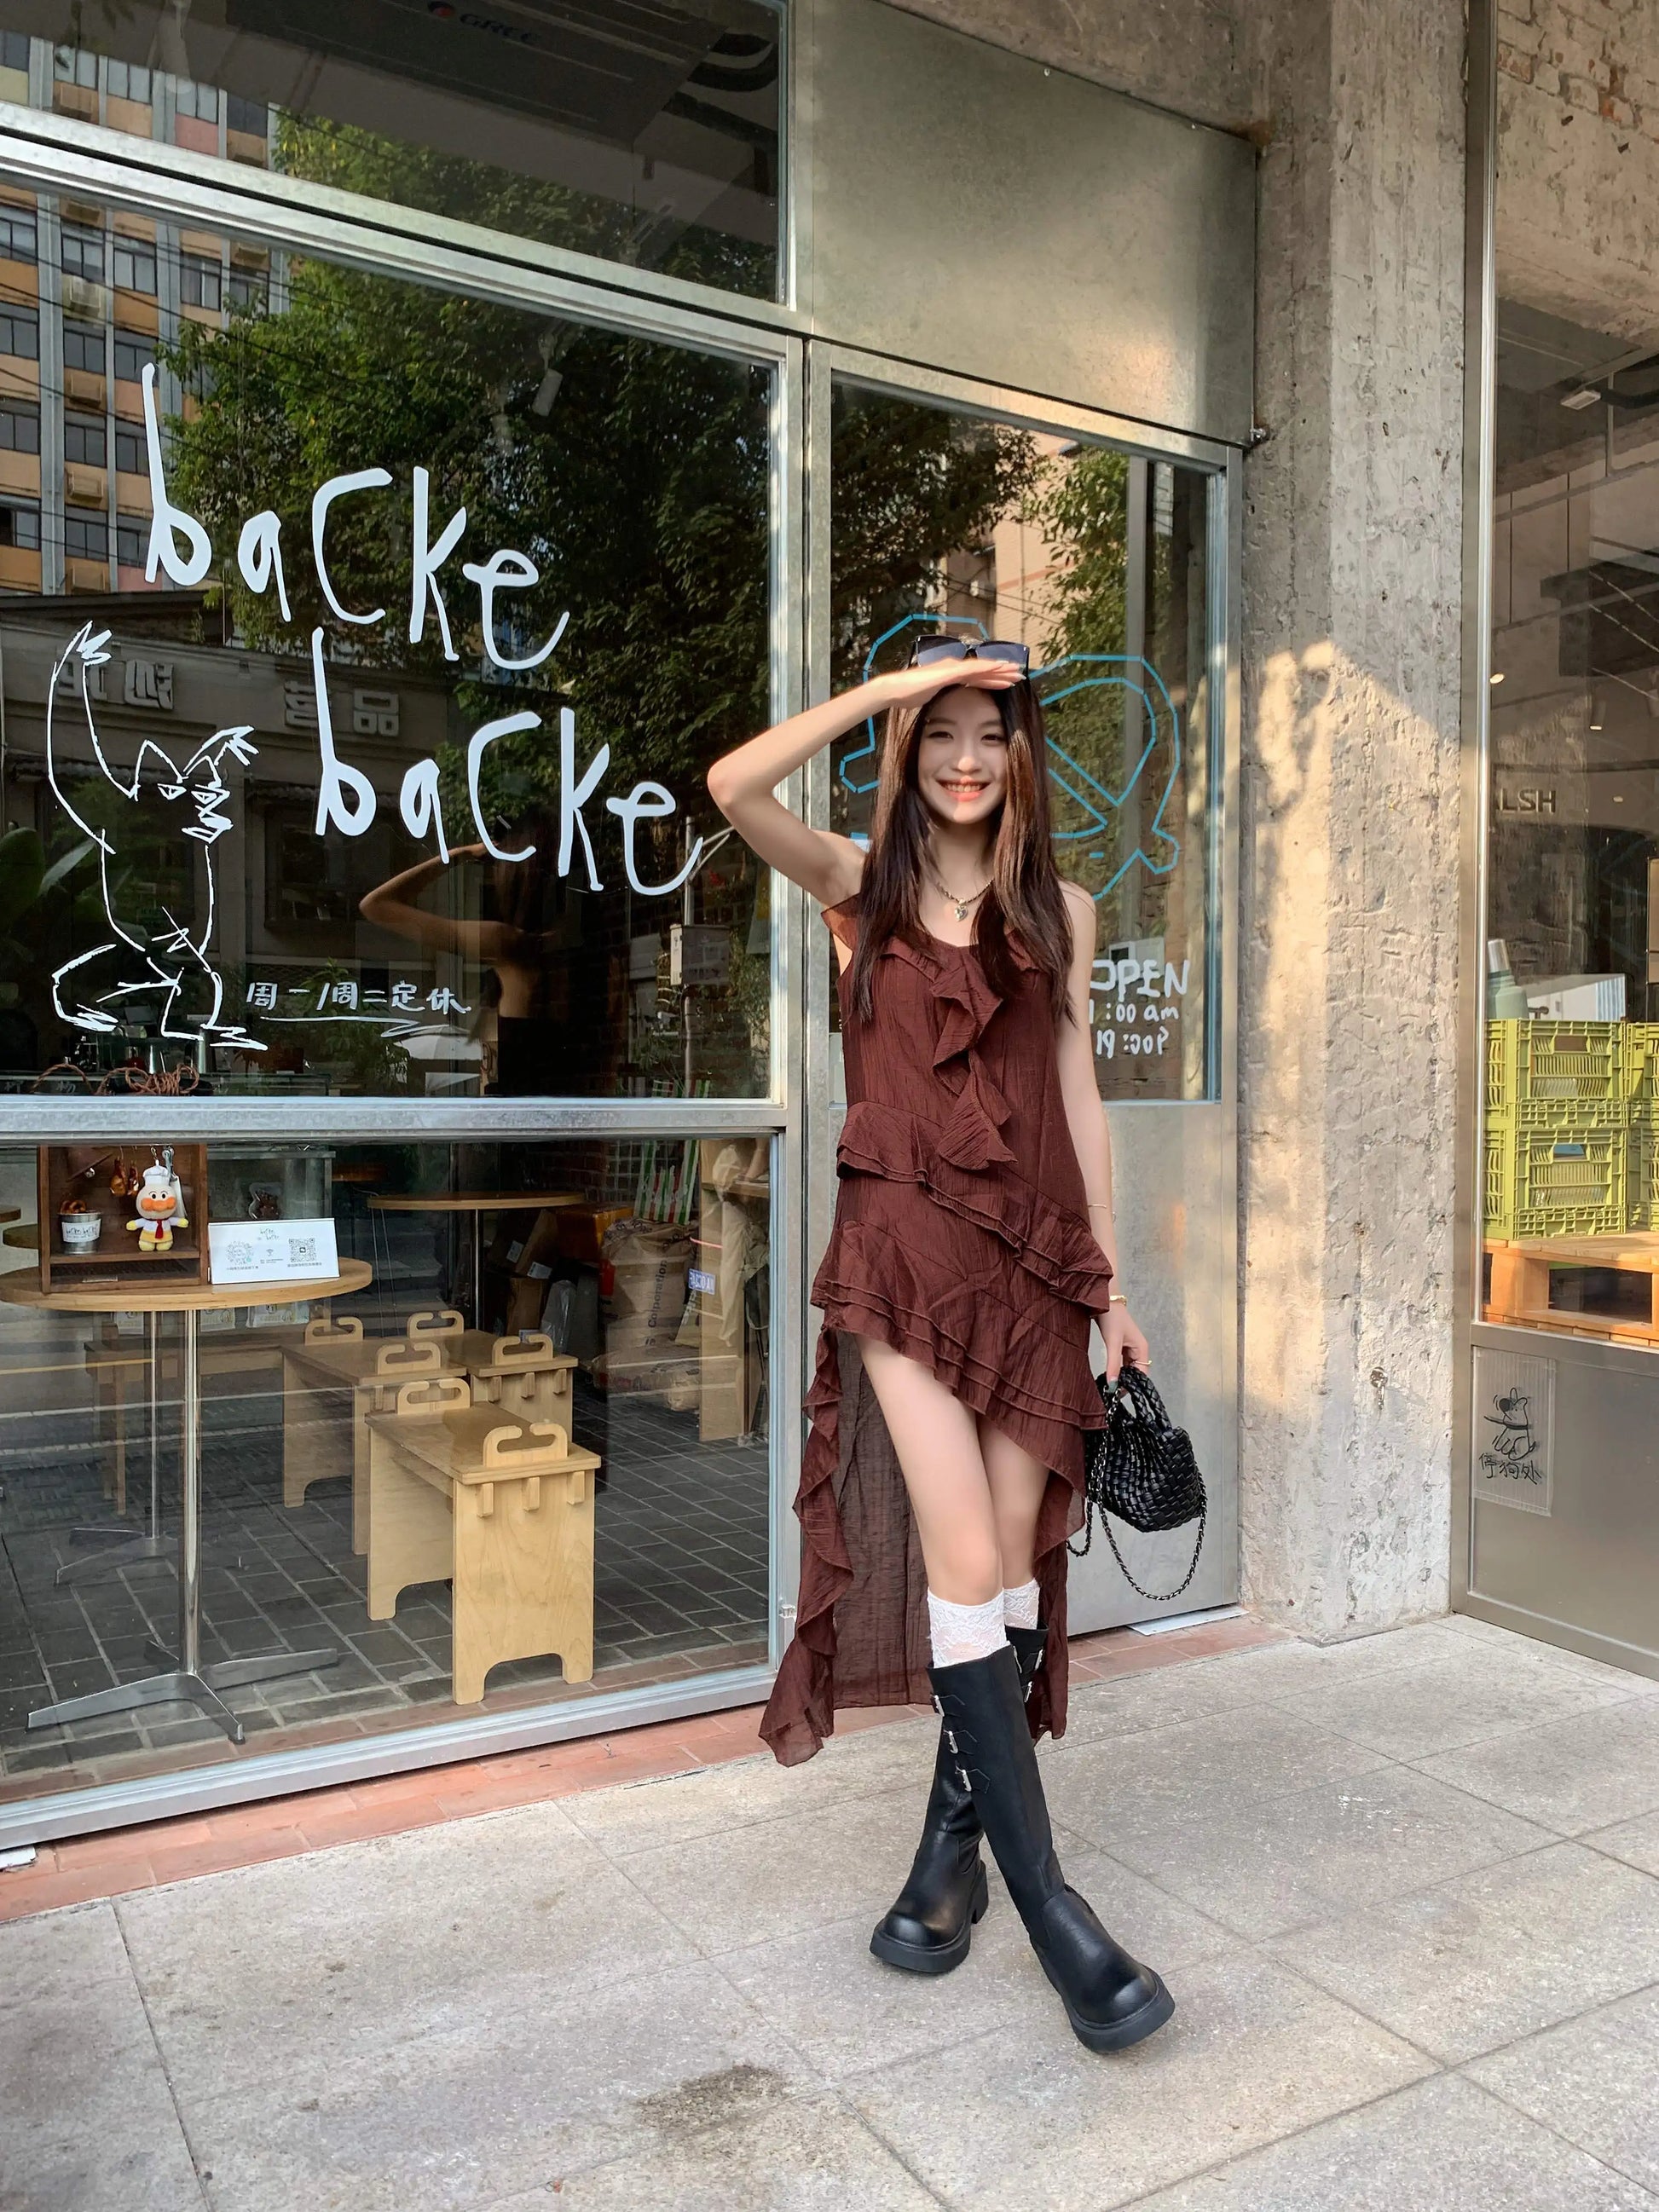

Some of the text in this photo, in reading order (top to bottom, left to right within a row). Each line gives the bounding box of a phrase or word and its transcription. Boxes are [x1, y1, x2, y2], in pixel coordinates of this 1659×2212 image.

[1494, 788, 1557, 815] LSH
[1143, 1004, 1179, 1022] am
[1478, 1453, 1542, 1485] 停狗处
